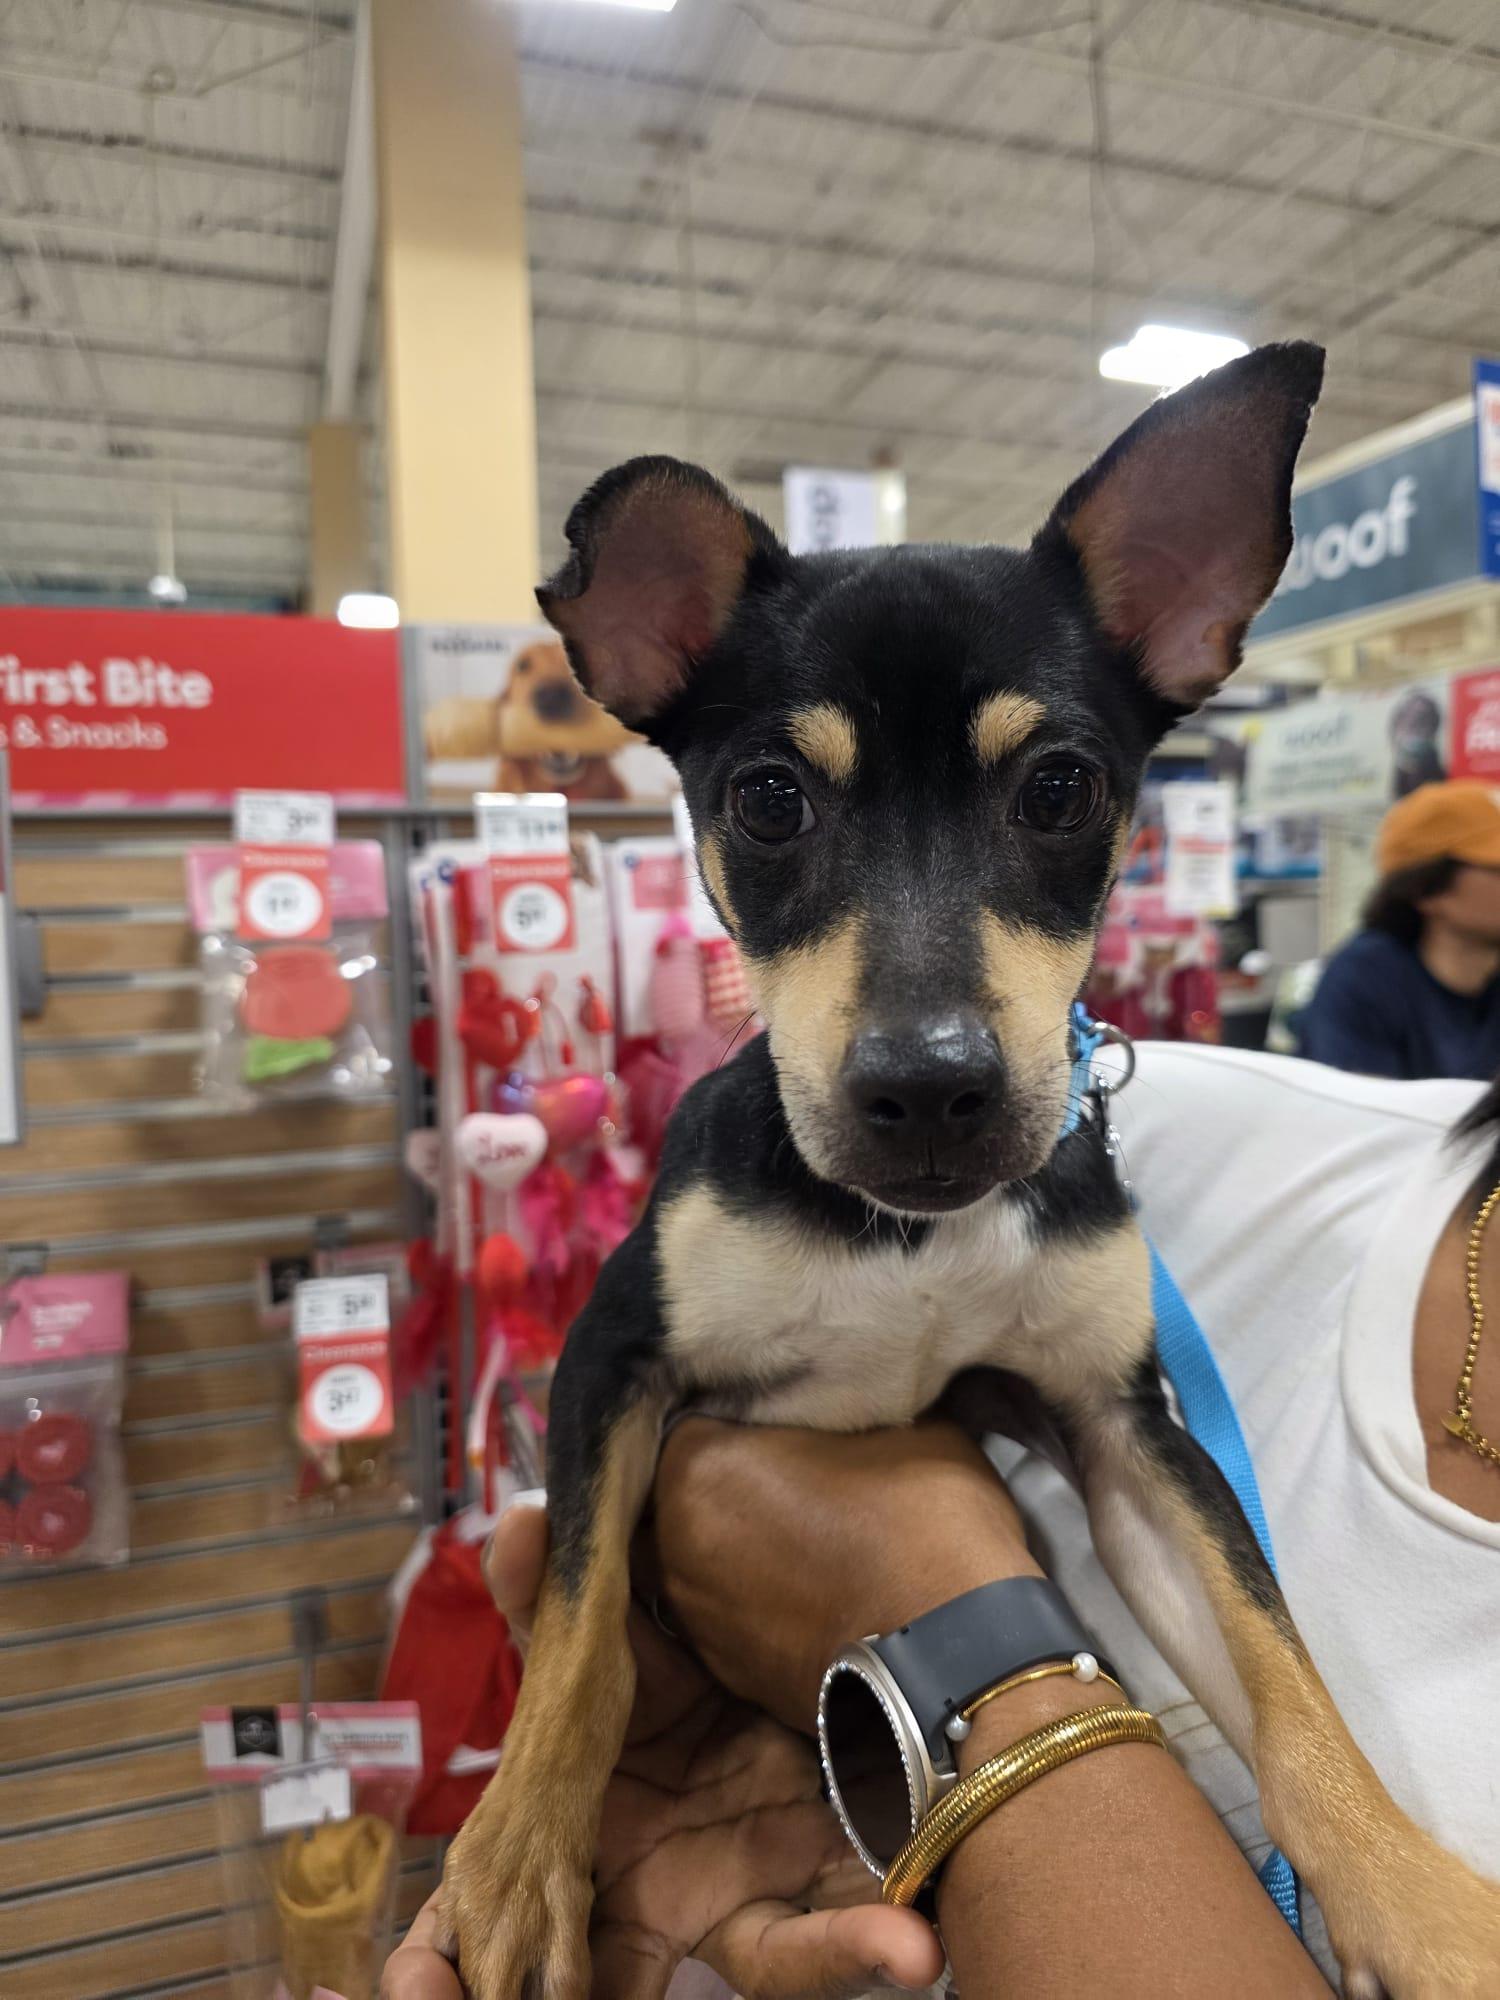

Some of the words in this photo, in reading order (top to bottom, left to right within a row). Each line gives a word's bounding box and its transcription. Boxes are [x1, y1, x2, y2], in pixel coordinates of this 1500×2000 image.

[103, 656, 213, 709] Bite
[13, 713, 43, 748] &
[46, 714, 169, 750] Snacks
